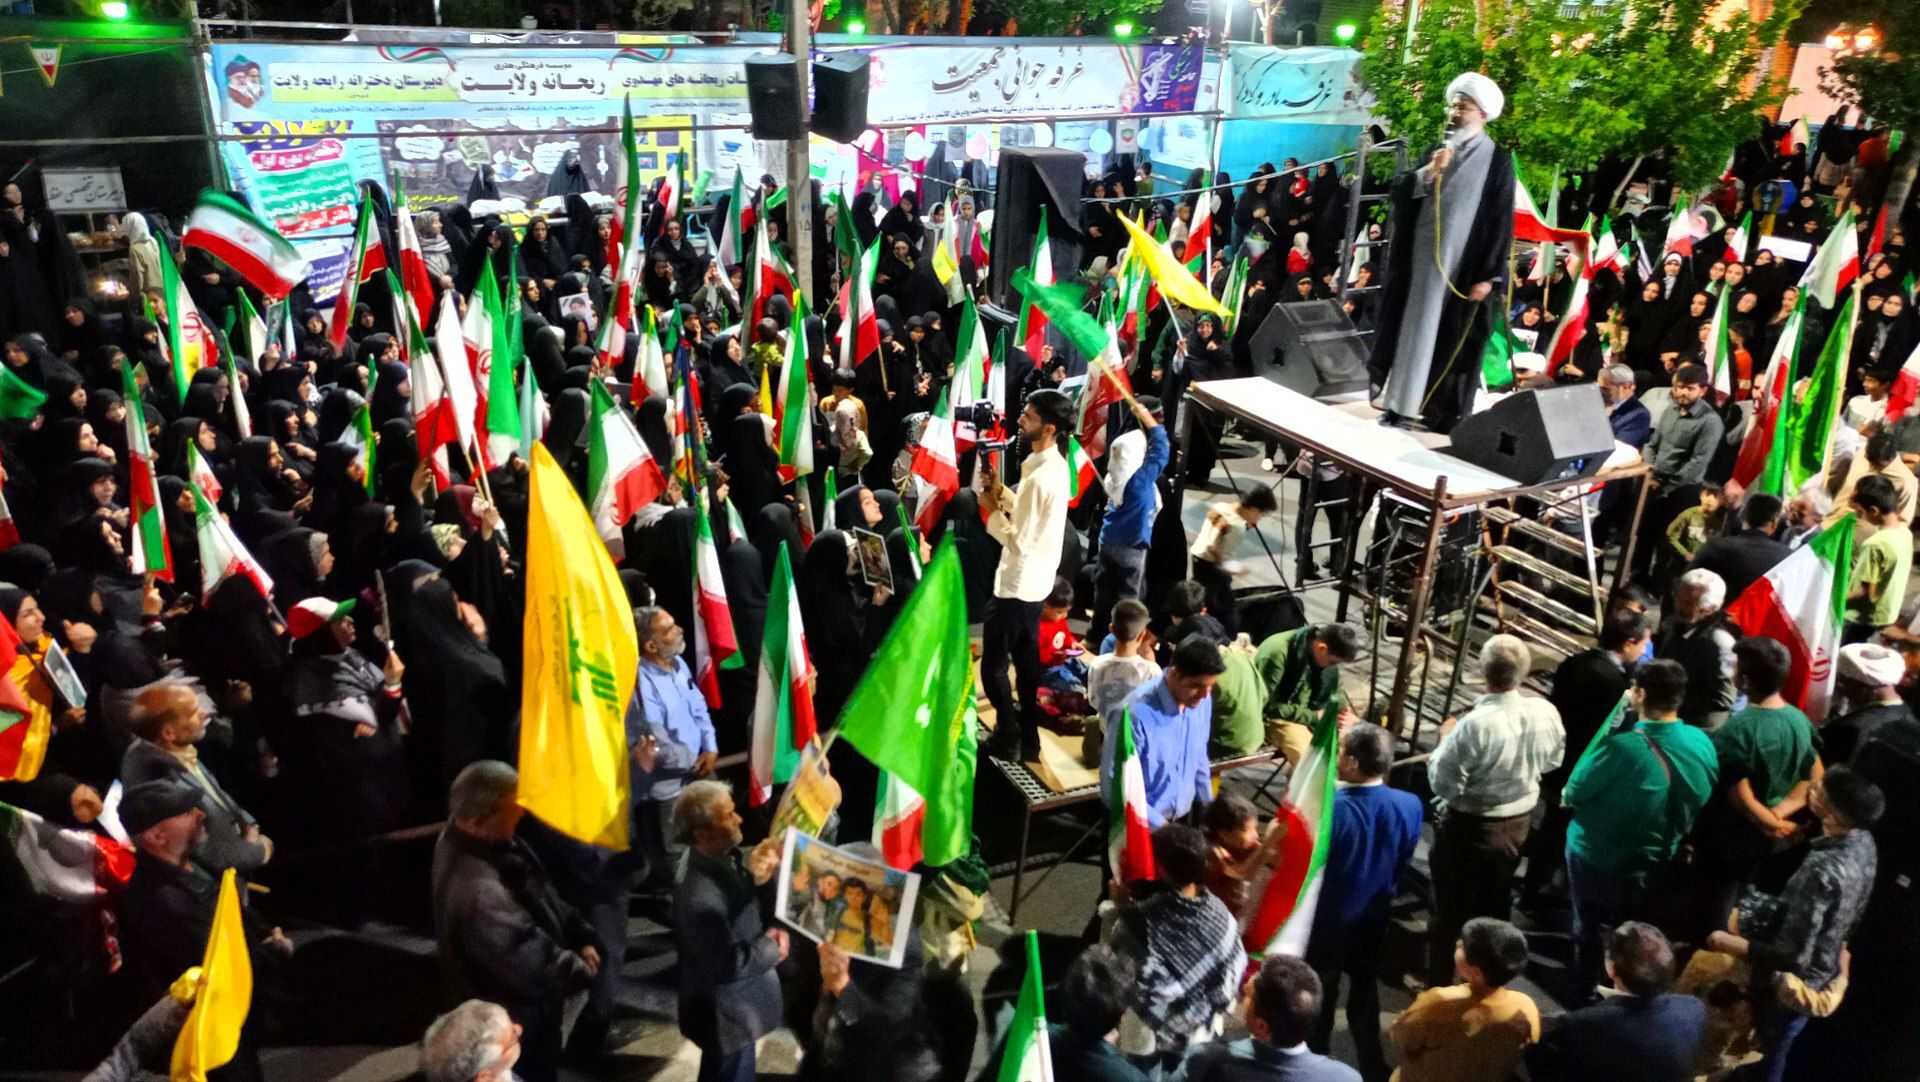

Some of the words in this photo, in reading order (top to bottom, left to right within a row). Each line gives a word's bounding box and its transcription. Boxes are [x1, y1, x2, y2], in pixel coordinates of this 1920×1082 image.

[515, 62, 543, 70] فرهنگی
[931, 46, 1005, 100] جمعیت
[1001, 44, 1045, 102] جوانی
[1047, 45, 1084, 94] غرفه
[274, 75, 309, 90] ولایت
[312, 75, 344, 90] رایحه
[347, 74, 392, 90] دخترانه
[394, 75, 443, 90] دبیرستان
[461, 72, 537, 95] ولایت
[542, 73, 605, 95] ریحانه
[622, 77, 663, 87] مهدوی
[665, 73, 685, 87] های
[686, 73, 725, 88] ریحانه
[1281, 70, 1333, 110] غرفه
[85, 185, 123, 202] دبیرستان
